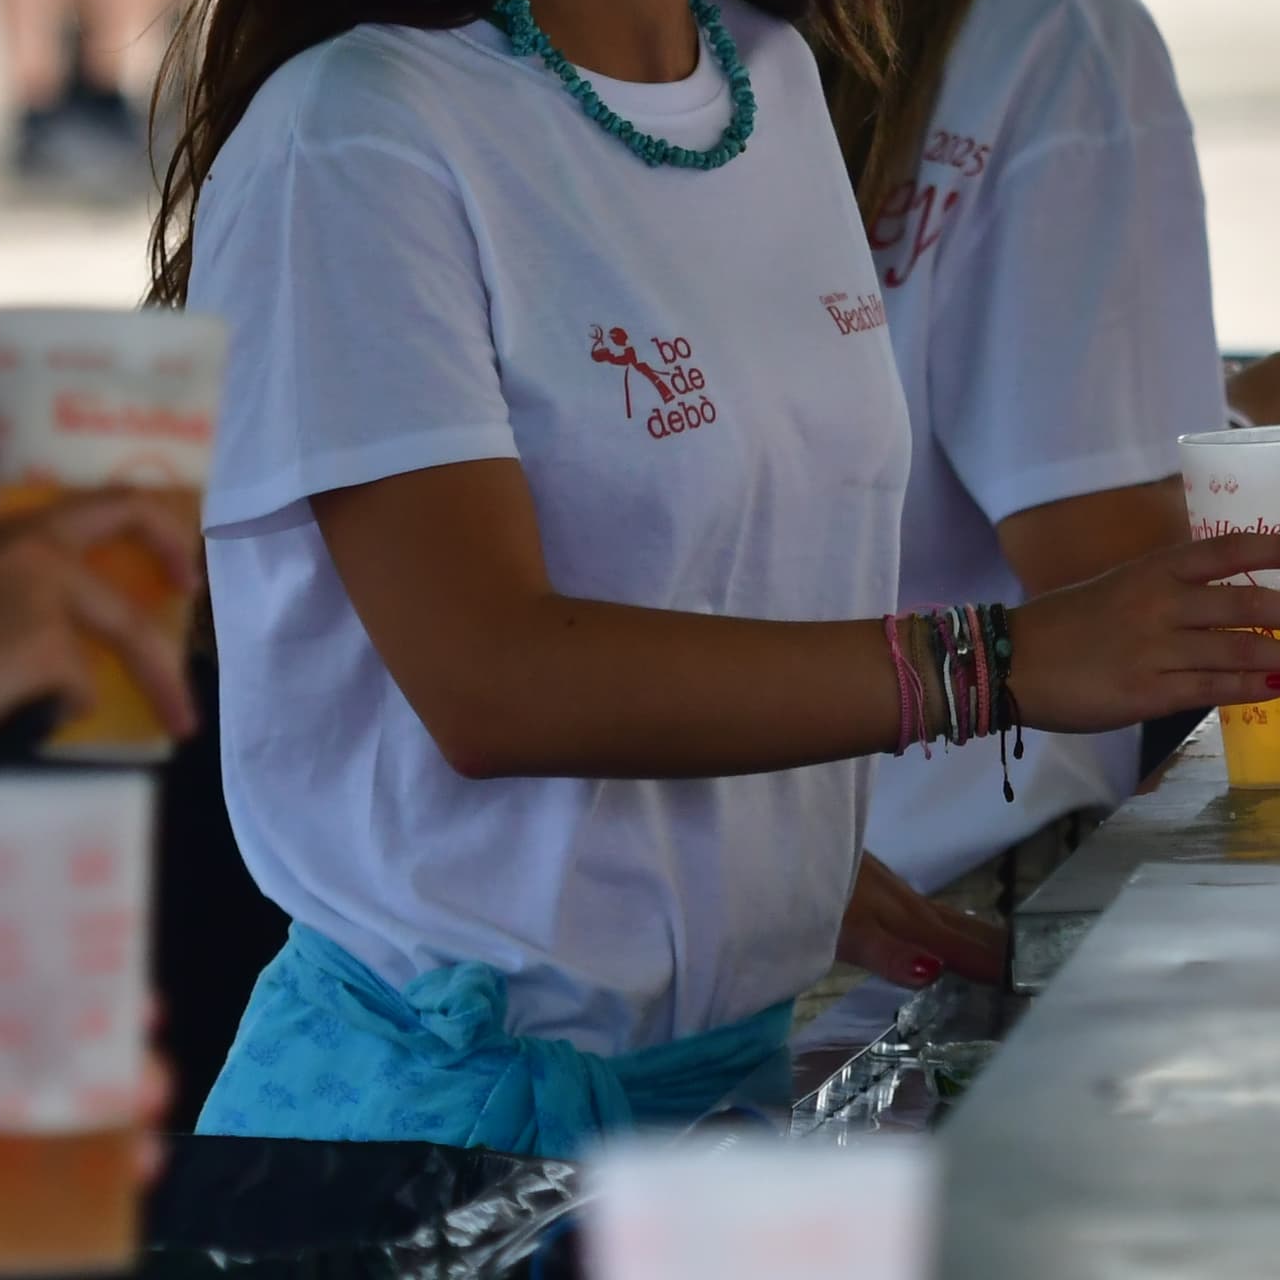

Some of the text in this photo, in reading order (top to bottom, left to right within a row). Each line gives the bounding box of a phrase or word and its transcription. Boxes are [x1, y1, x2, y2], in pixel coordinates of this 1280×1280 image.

[649, 336, 692, 365] bo
[670, 365, 706, 395] de
[647, 395, 716, 439] debò
